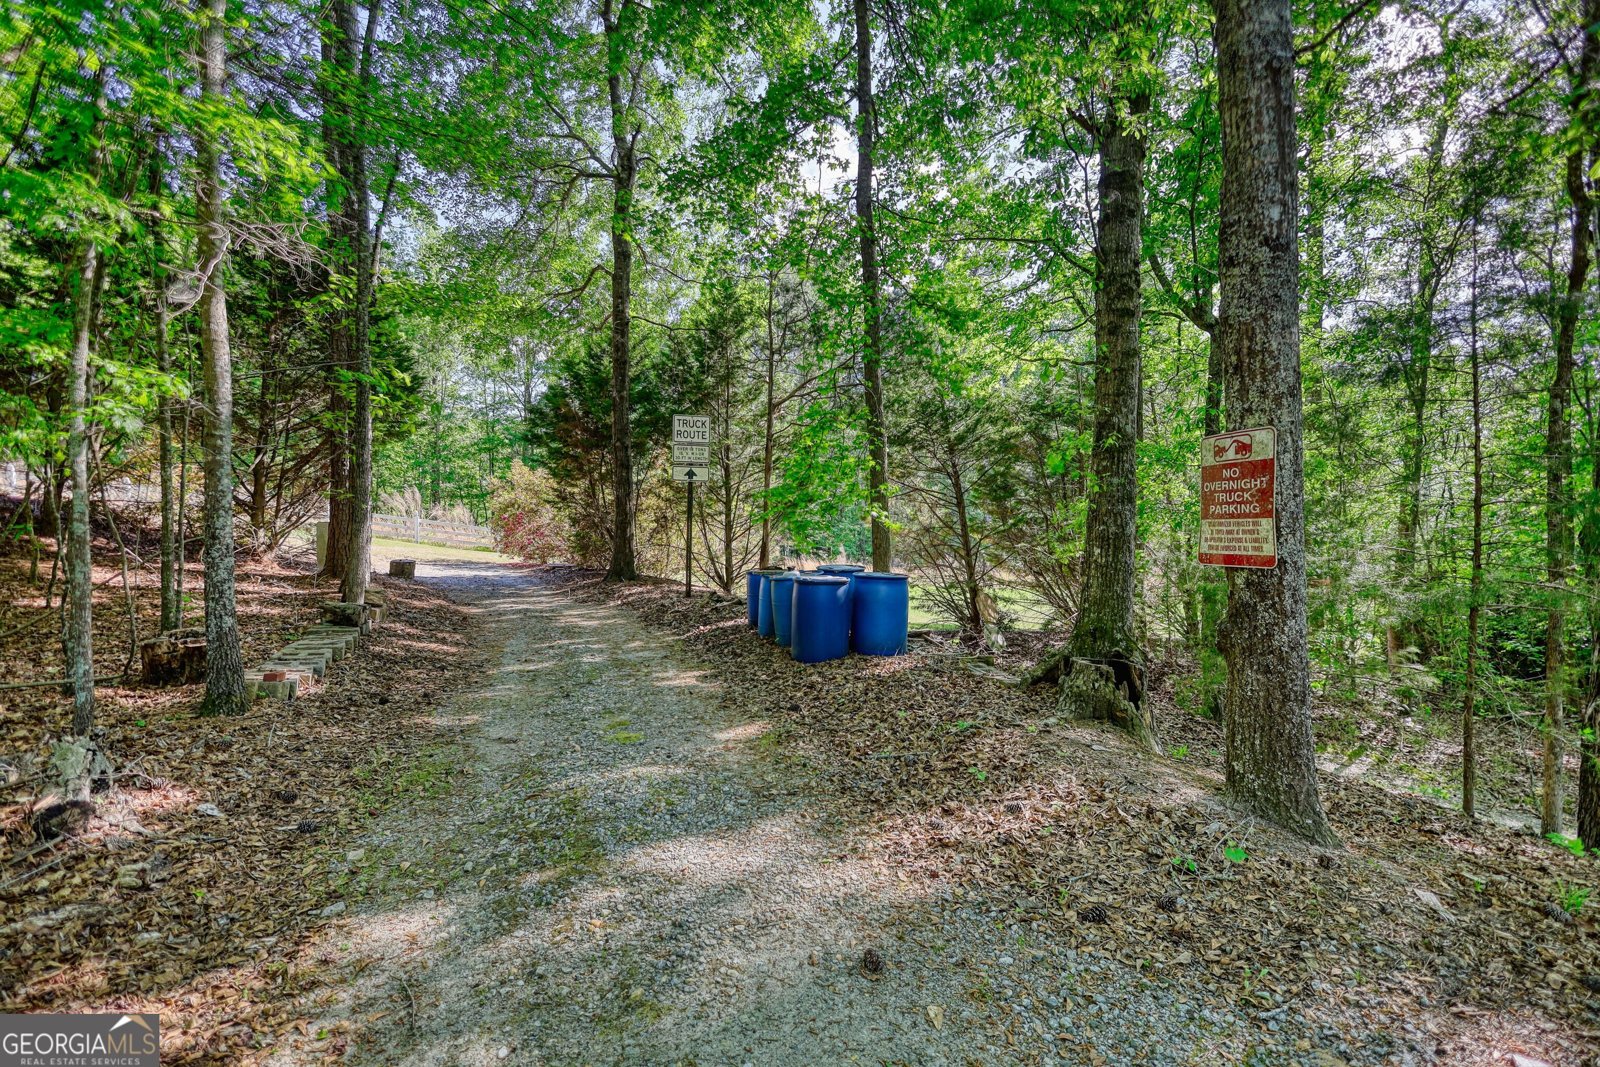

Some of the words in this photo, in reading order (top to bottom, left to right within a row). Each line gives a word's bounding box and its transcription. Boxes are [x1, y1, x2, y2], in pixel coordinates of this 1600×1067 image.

[676, 419, 707, 429] TRUCK
[676, 430, 707, 439] ROUTE
[1222, 467, 1240, 478] NO
[1203, 477, 1267, 491] OVERNIGHT
[1214, 491, 1252, 502] TRUCK
[1209, 503, 1260, 514] PARKING
